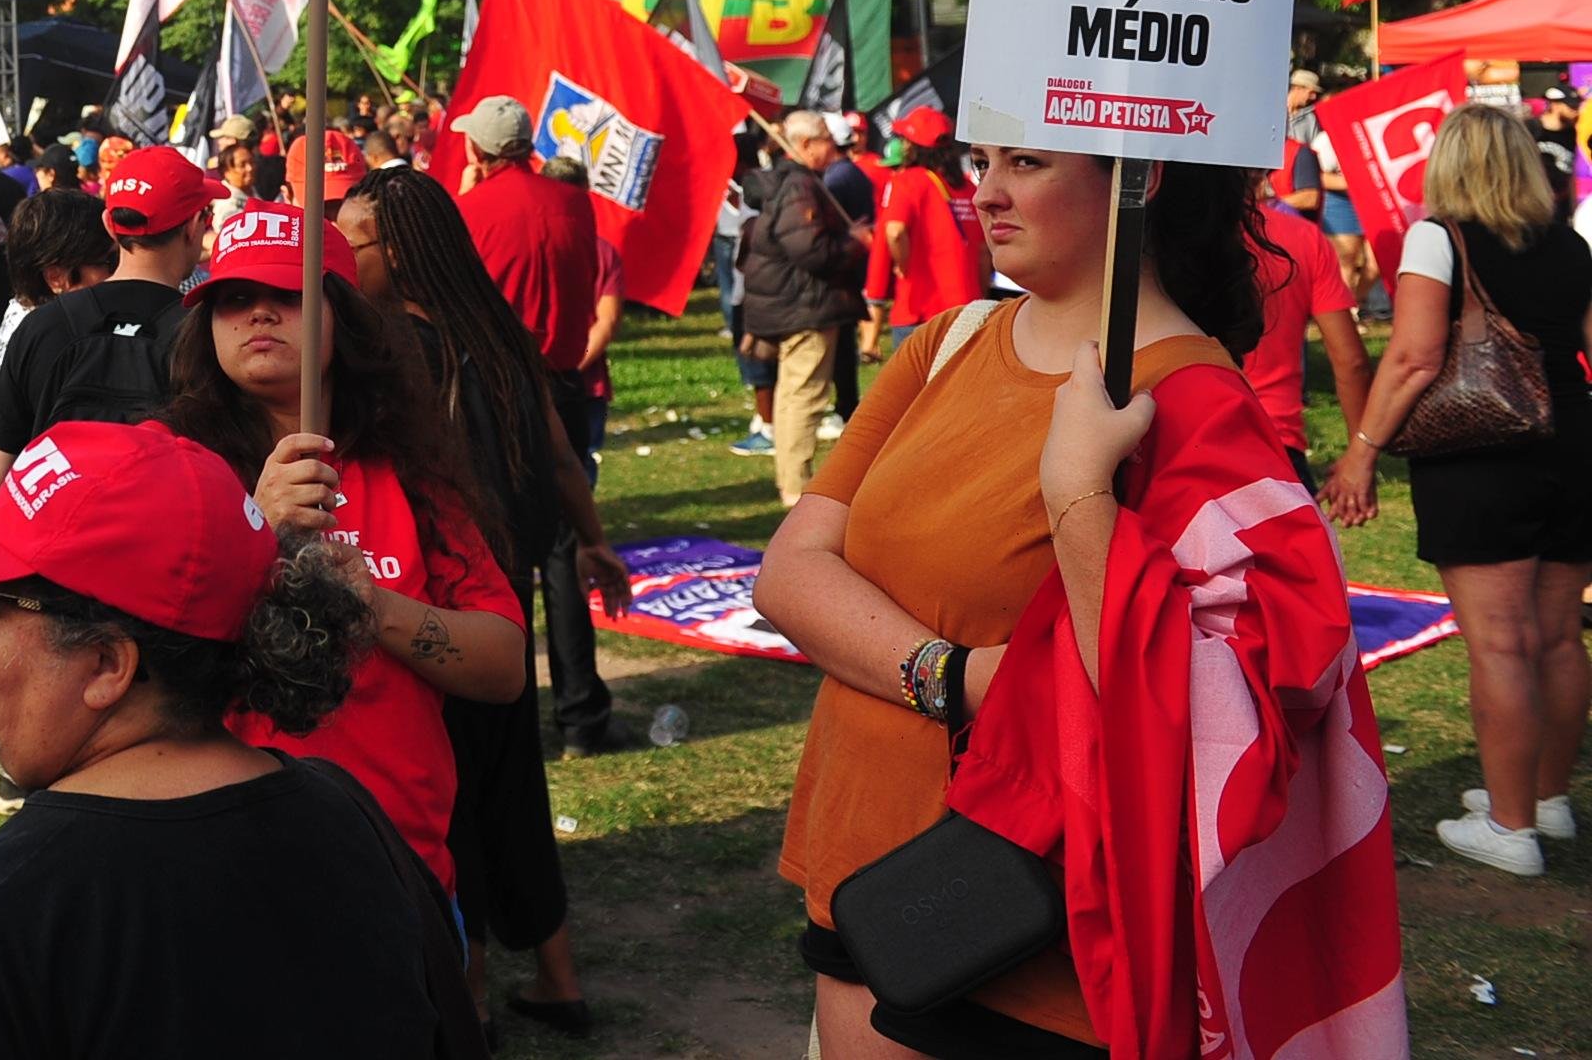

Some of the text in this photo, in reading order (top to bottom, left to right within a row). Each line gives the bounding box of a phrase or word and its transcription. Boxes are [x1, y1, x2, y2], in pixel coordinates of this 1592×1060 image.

[1047, 77, 1093, 90] DIÁLOGO E
[1048, 94, 1208, 128] AÇÃO PETISTA PT
[110, 177, 152, 196] MST
[31, 471, 83, 511] BRASIL
[362, 549, 402, 579] ÃO
